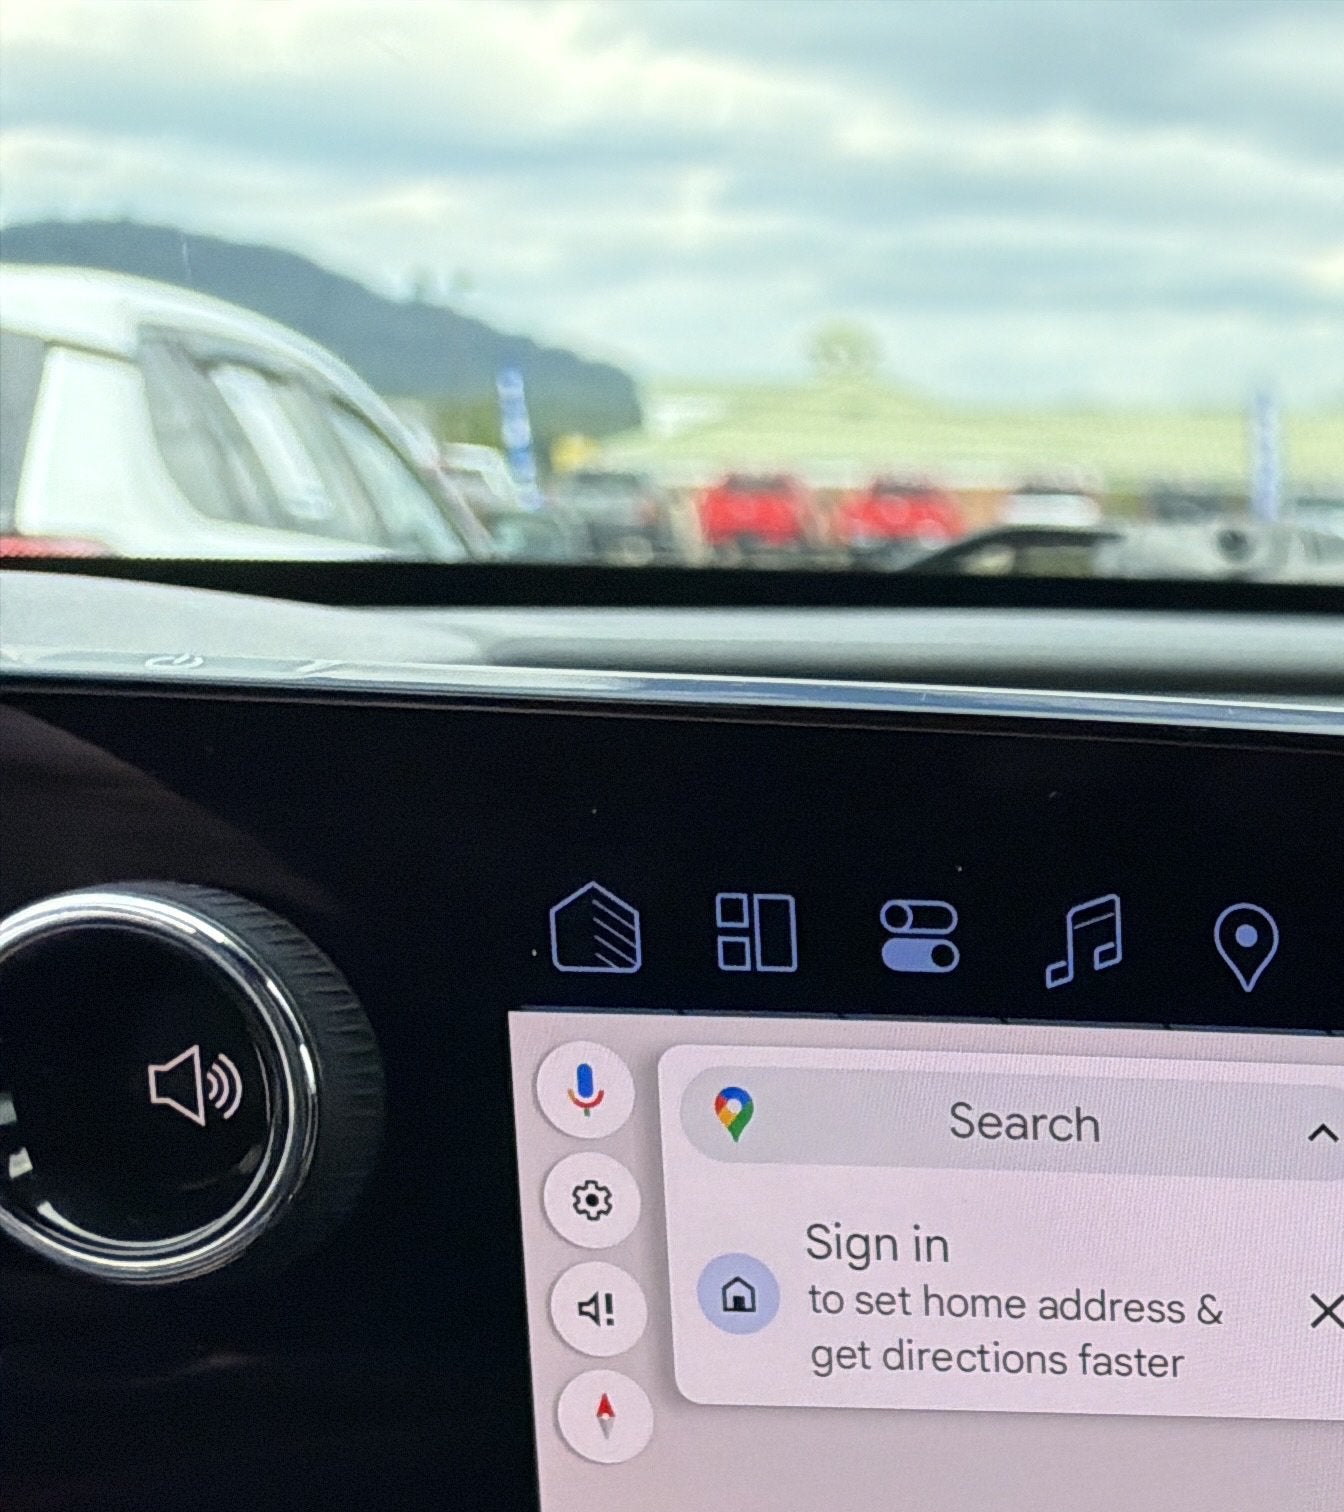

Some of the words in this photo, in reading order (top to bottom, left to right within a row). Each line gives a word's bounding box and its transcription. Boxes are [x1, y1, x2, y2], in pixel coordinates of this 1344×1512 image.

[950, 1101, 1100, 1143] Search
[806, 1221, 898, 1272] Sign
[913, 1223, 949, 1263] in
[807, 1284, 845, 1315] to
[855, 1286, 912, 1316] set
[923, 1283, 1027, 1320] home
[1038, 1287, 1186, 1324] address
[1197, 1293, 1223, 1325] &
[811, 1340, 872, 1378] get
[882, 1337, 1068, 1376] directions
[1078, 1342, 1185, 1378] faster
